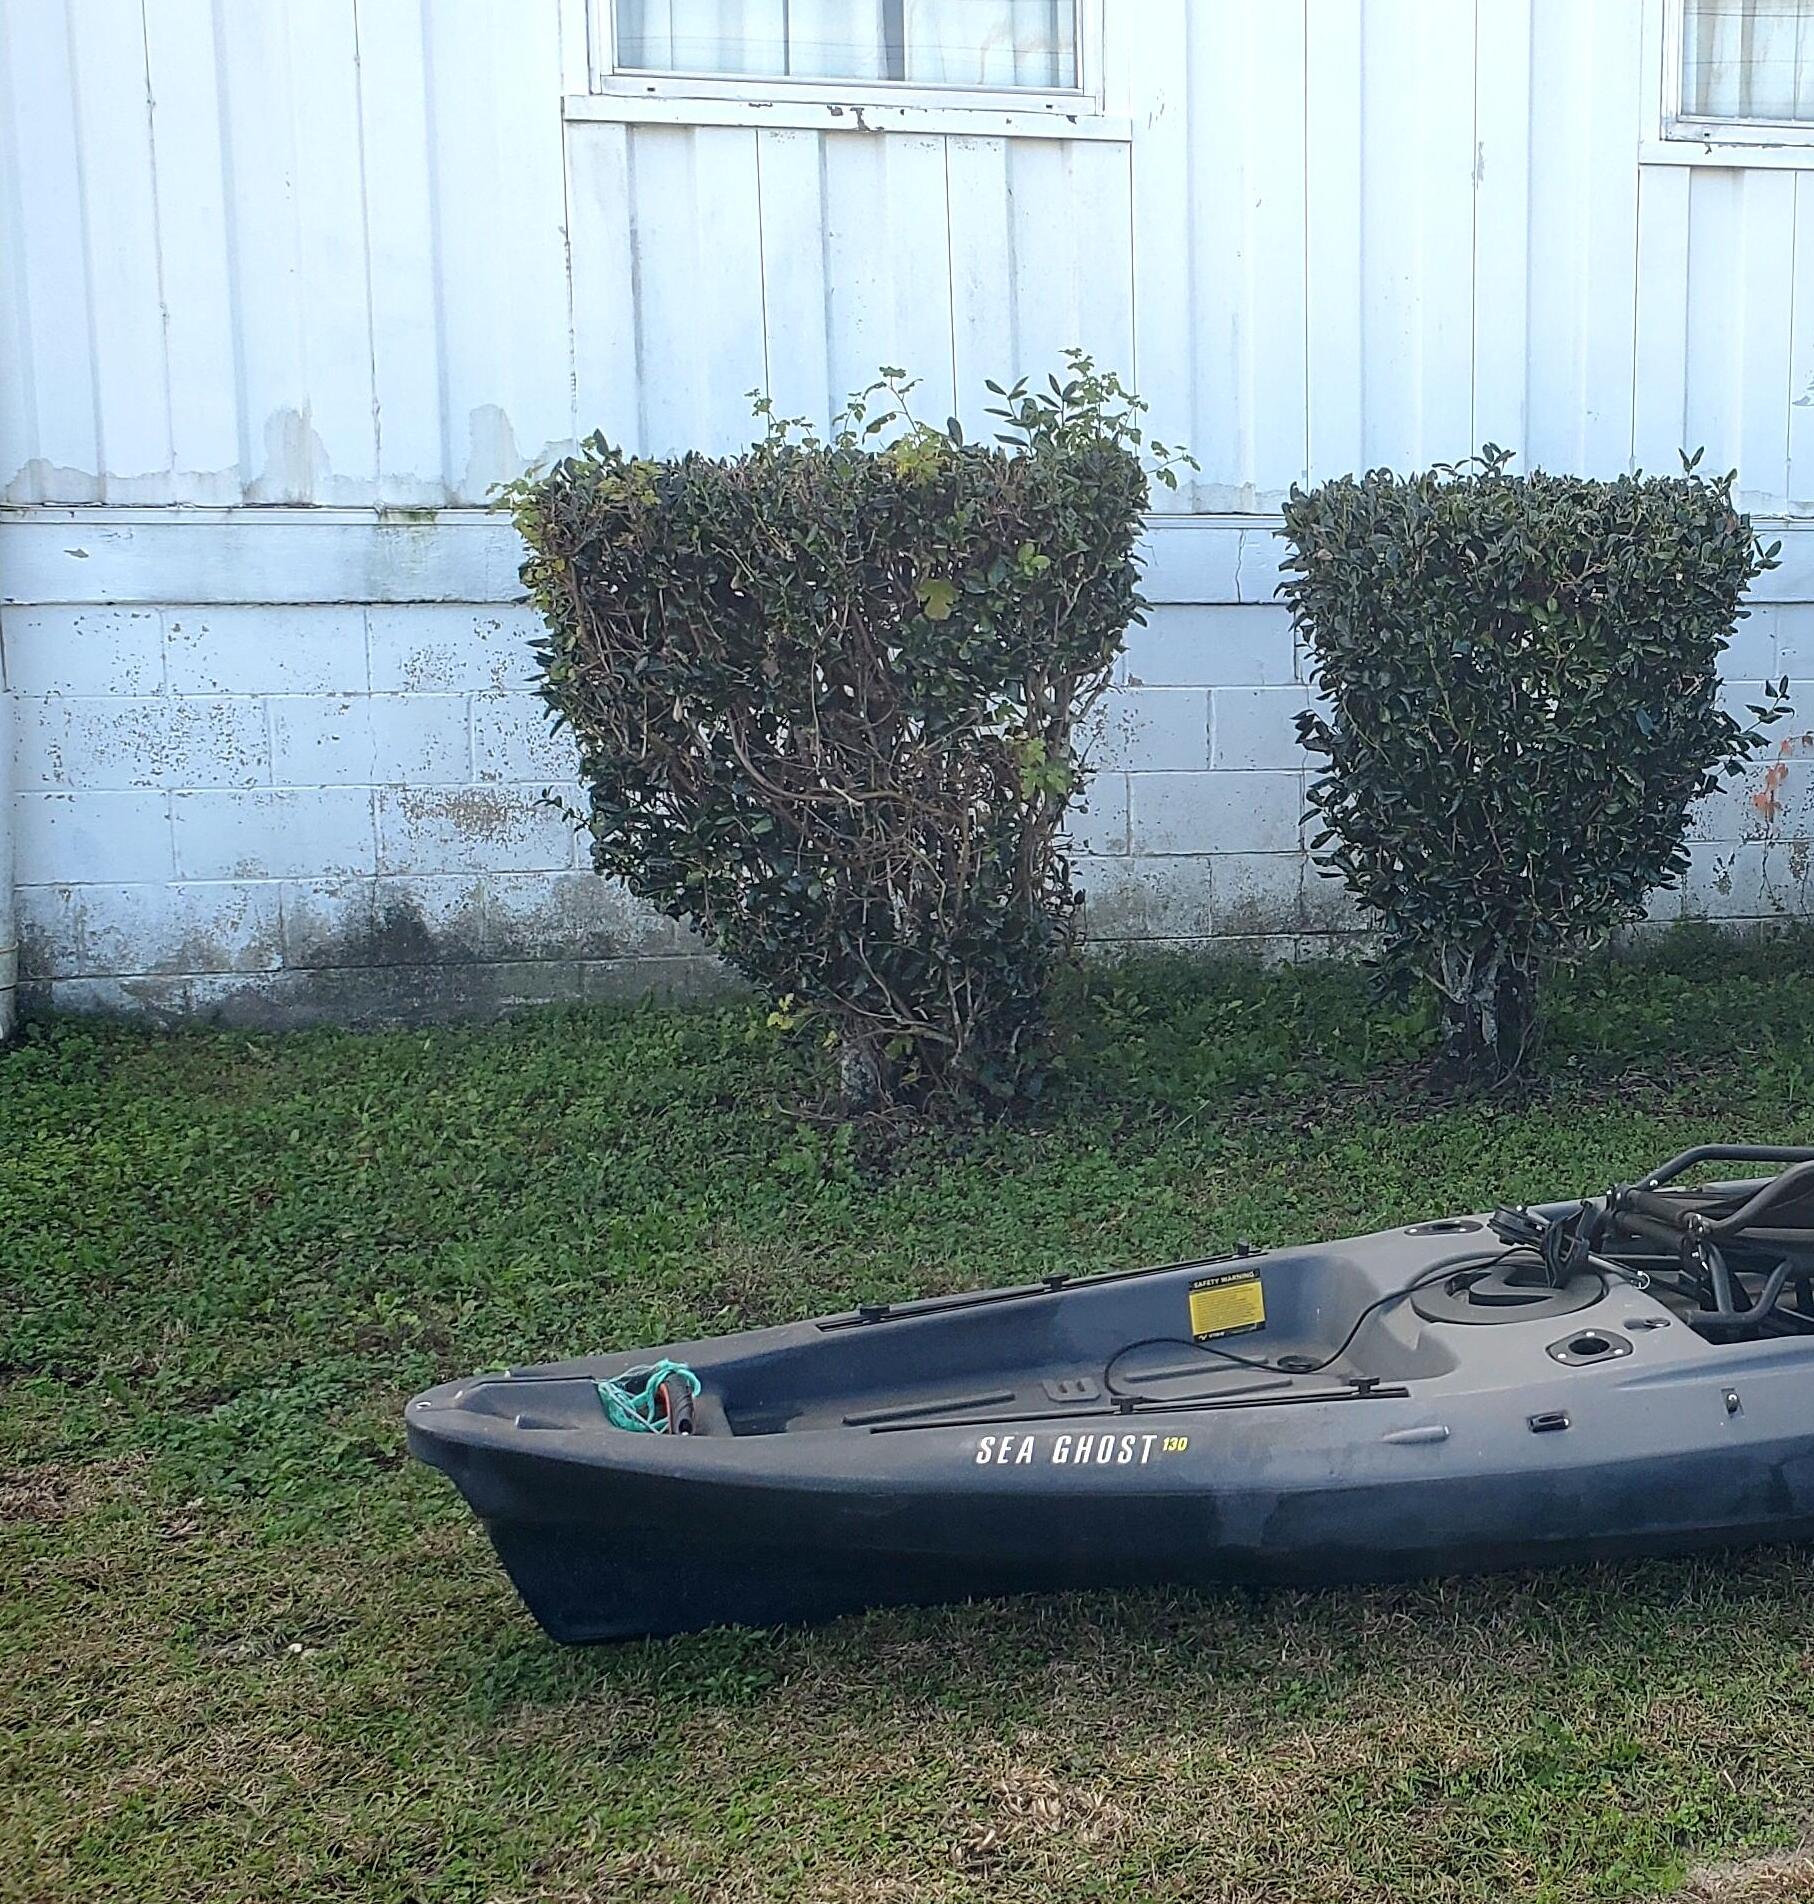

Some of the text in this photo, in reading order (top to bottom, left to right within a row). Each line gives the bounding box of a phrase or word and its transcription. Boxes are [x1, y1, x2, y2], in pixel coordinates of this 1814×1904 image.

[1193, 1271, 1254, 1288] SAFETY WARNING
[976, 1434, 1188, 1464] SEA GHOST 130
